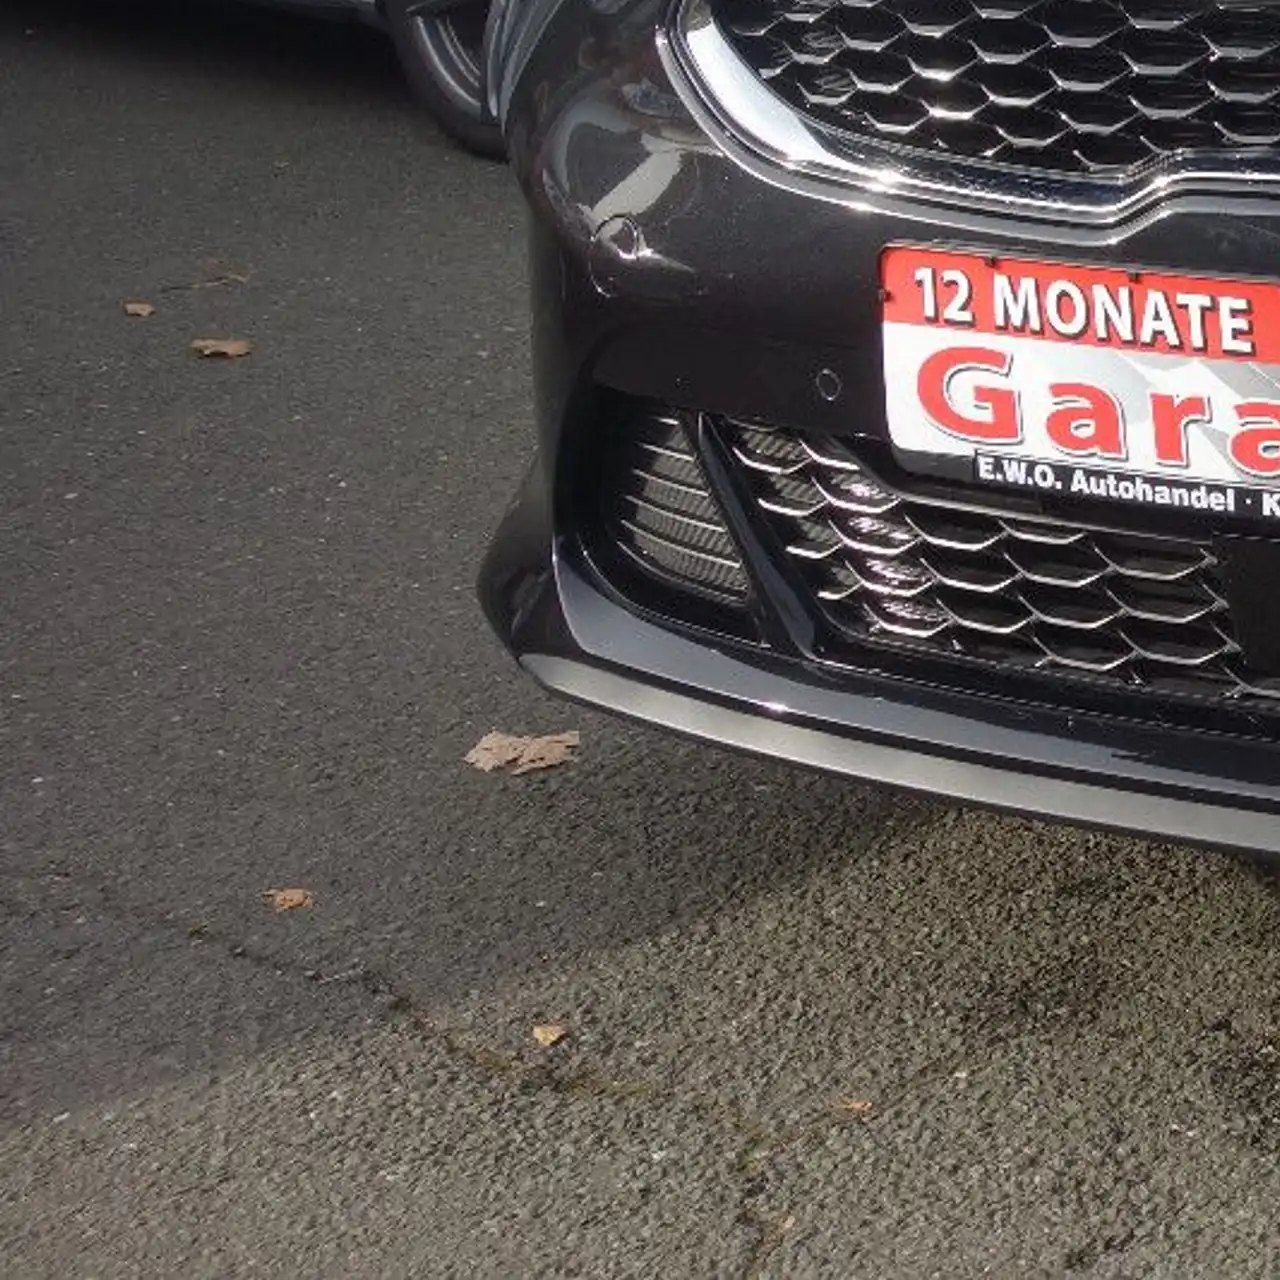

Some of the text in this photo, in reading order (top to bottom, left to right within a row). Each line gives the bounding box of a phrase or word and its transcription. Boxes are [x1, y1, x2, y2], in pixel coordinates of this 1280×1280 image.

[914, 266, 1256, 357] 12 MONATE
[978, 455, 1062, 490] E.W.O.
[1071, 468, 1236, 512] Autohandel
